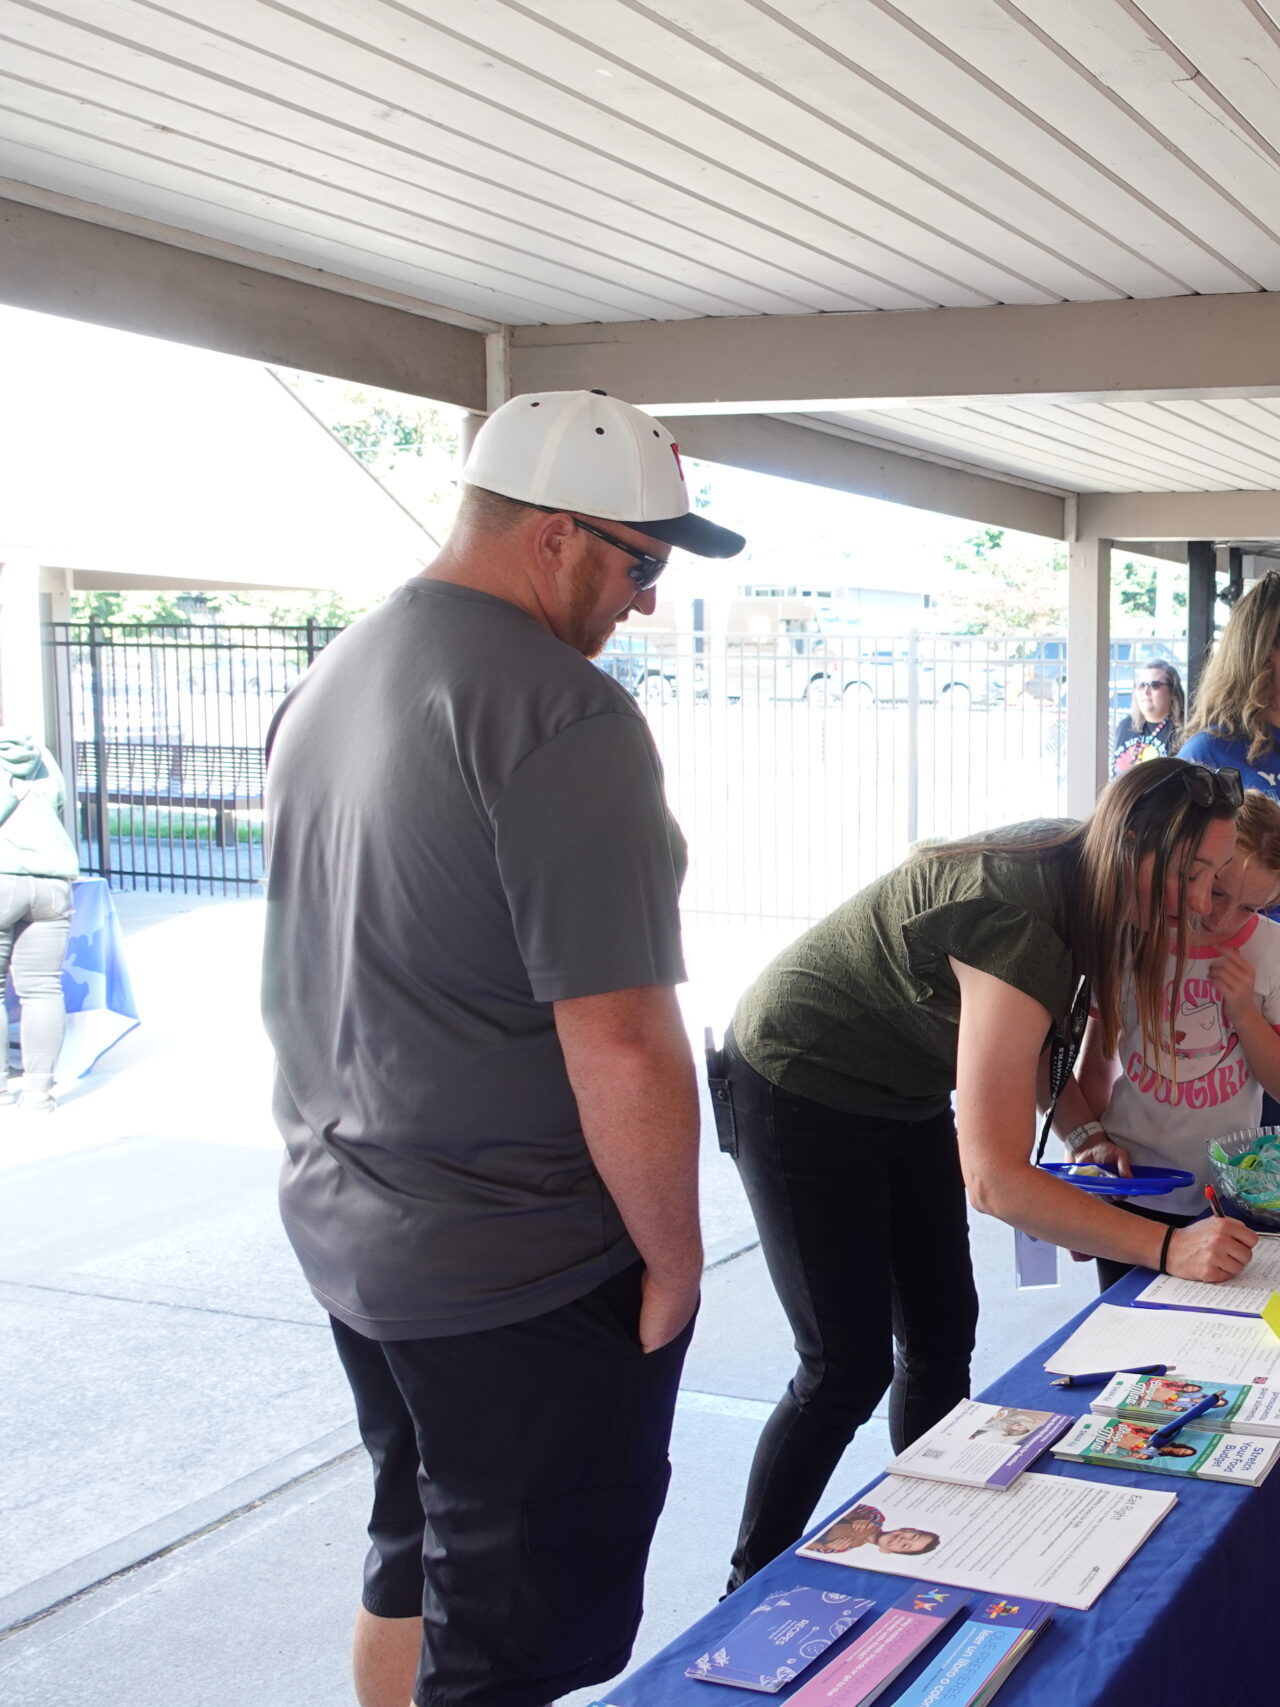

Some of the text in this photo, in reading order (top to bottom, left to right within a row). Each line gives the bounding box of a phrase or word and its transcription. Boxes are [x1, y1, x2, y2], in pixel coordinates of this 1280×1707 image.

[1126, 1052, 1250, 1109] COWGIRL
[1211, 1444, 1236, 1467] Budget
[1235, 1442, 1252, 1458] Your
[1242, 1447, 1264, 1471] Stretch
[1223, 1457, 1242, 1472] Food
[1111, 1494, 1143, 1521] Eat Right
[775, 1619, 810, 1646] RECIPES
[973, 1629, 992, 1645] leer
[963, 1645, 977, 1657] un
[946, 1658, 970, 1677] libro
